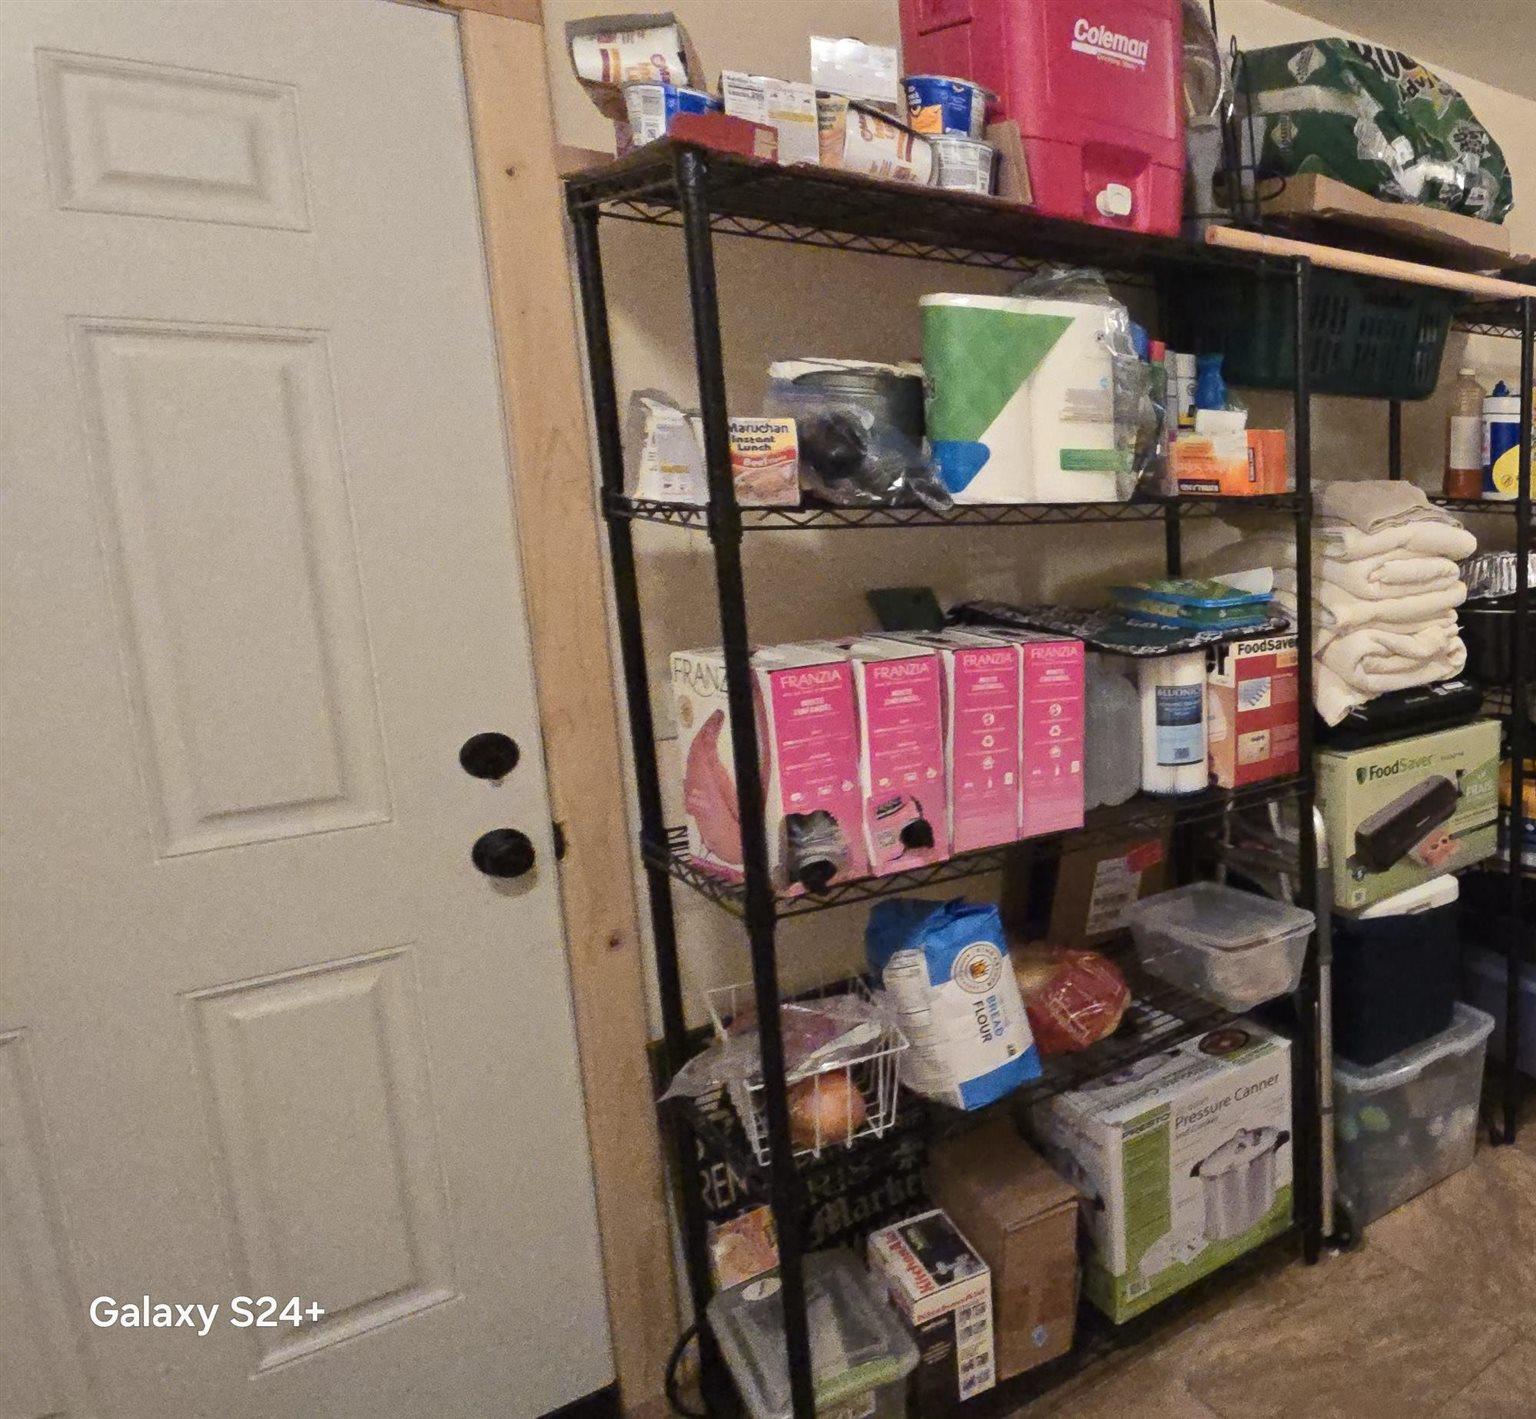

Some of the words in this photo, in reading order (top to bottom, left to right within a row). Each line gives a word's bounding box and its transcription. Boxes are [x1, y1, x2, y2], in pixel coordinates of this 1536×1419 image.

[1074, 18, 1149, 60] Coleman
[728, 423, 788, 433] Maruchan
[1031, 645, 1077, 660] FRANZIA
[1238, 637, 1298, 656] FoodSave
[873, 662, 930, 680] FRANZIA
[962, 653, 1013, 668] FRANZIA
[779, 669, 842, 688] FRANZIA
[1369, 754, 1434, 781] FoodSaver
[973, 1000, 993, 1044] FLOUR
[986, 995, 1005, 1037] BREAD
[1233, 1073, 1280, 1102] Canner
[1174, 1093, 1231, 1130] Pressure
